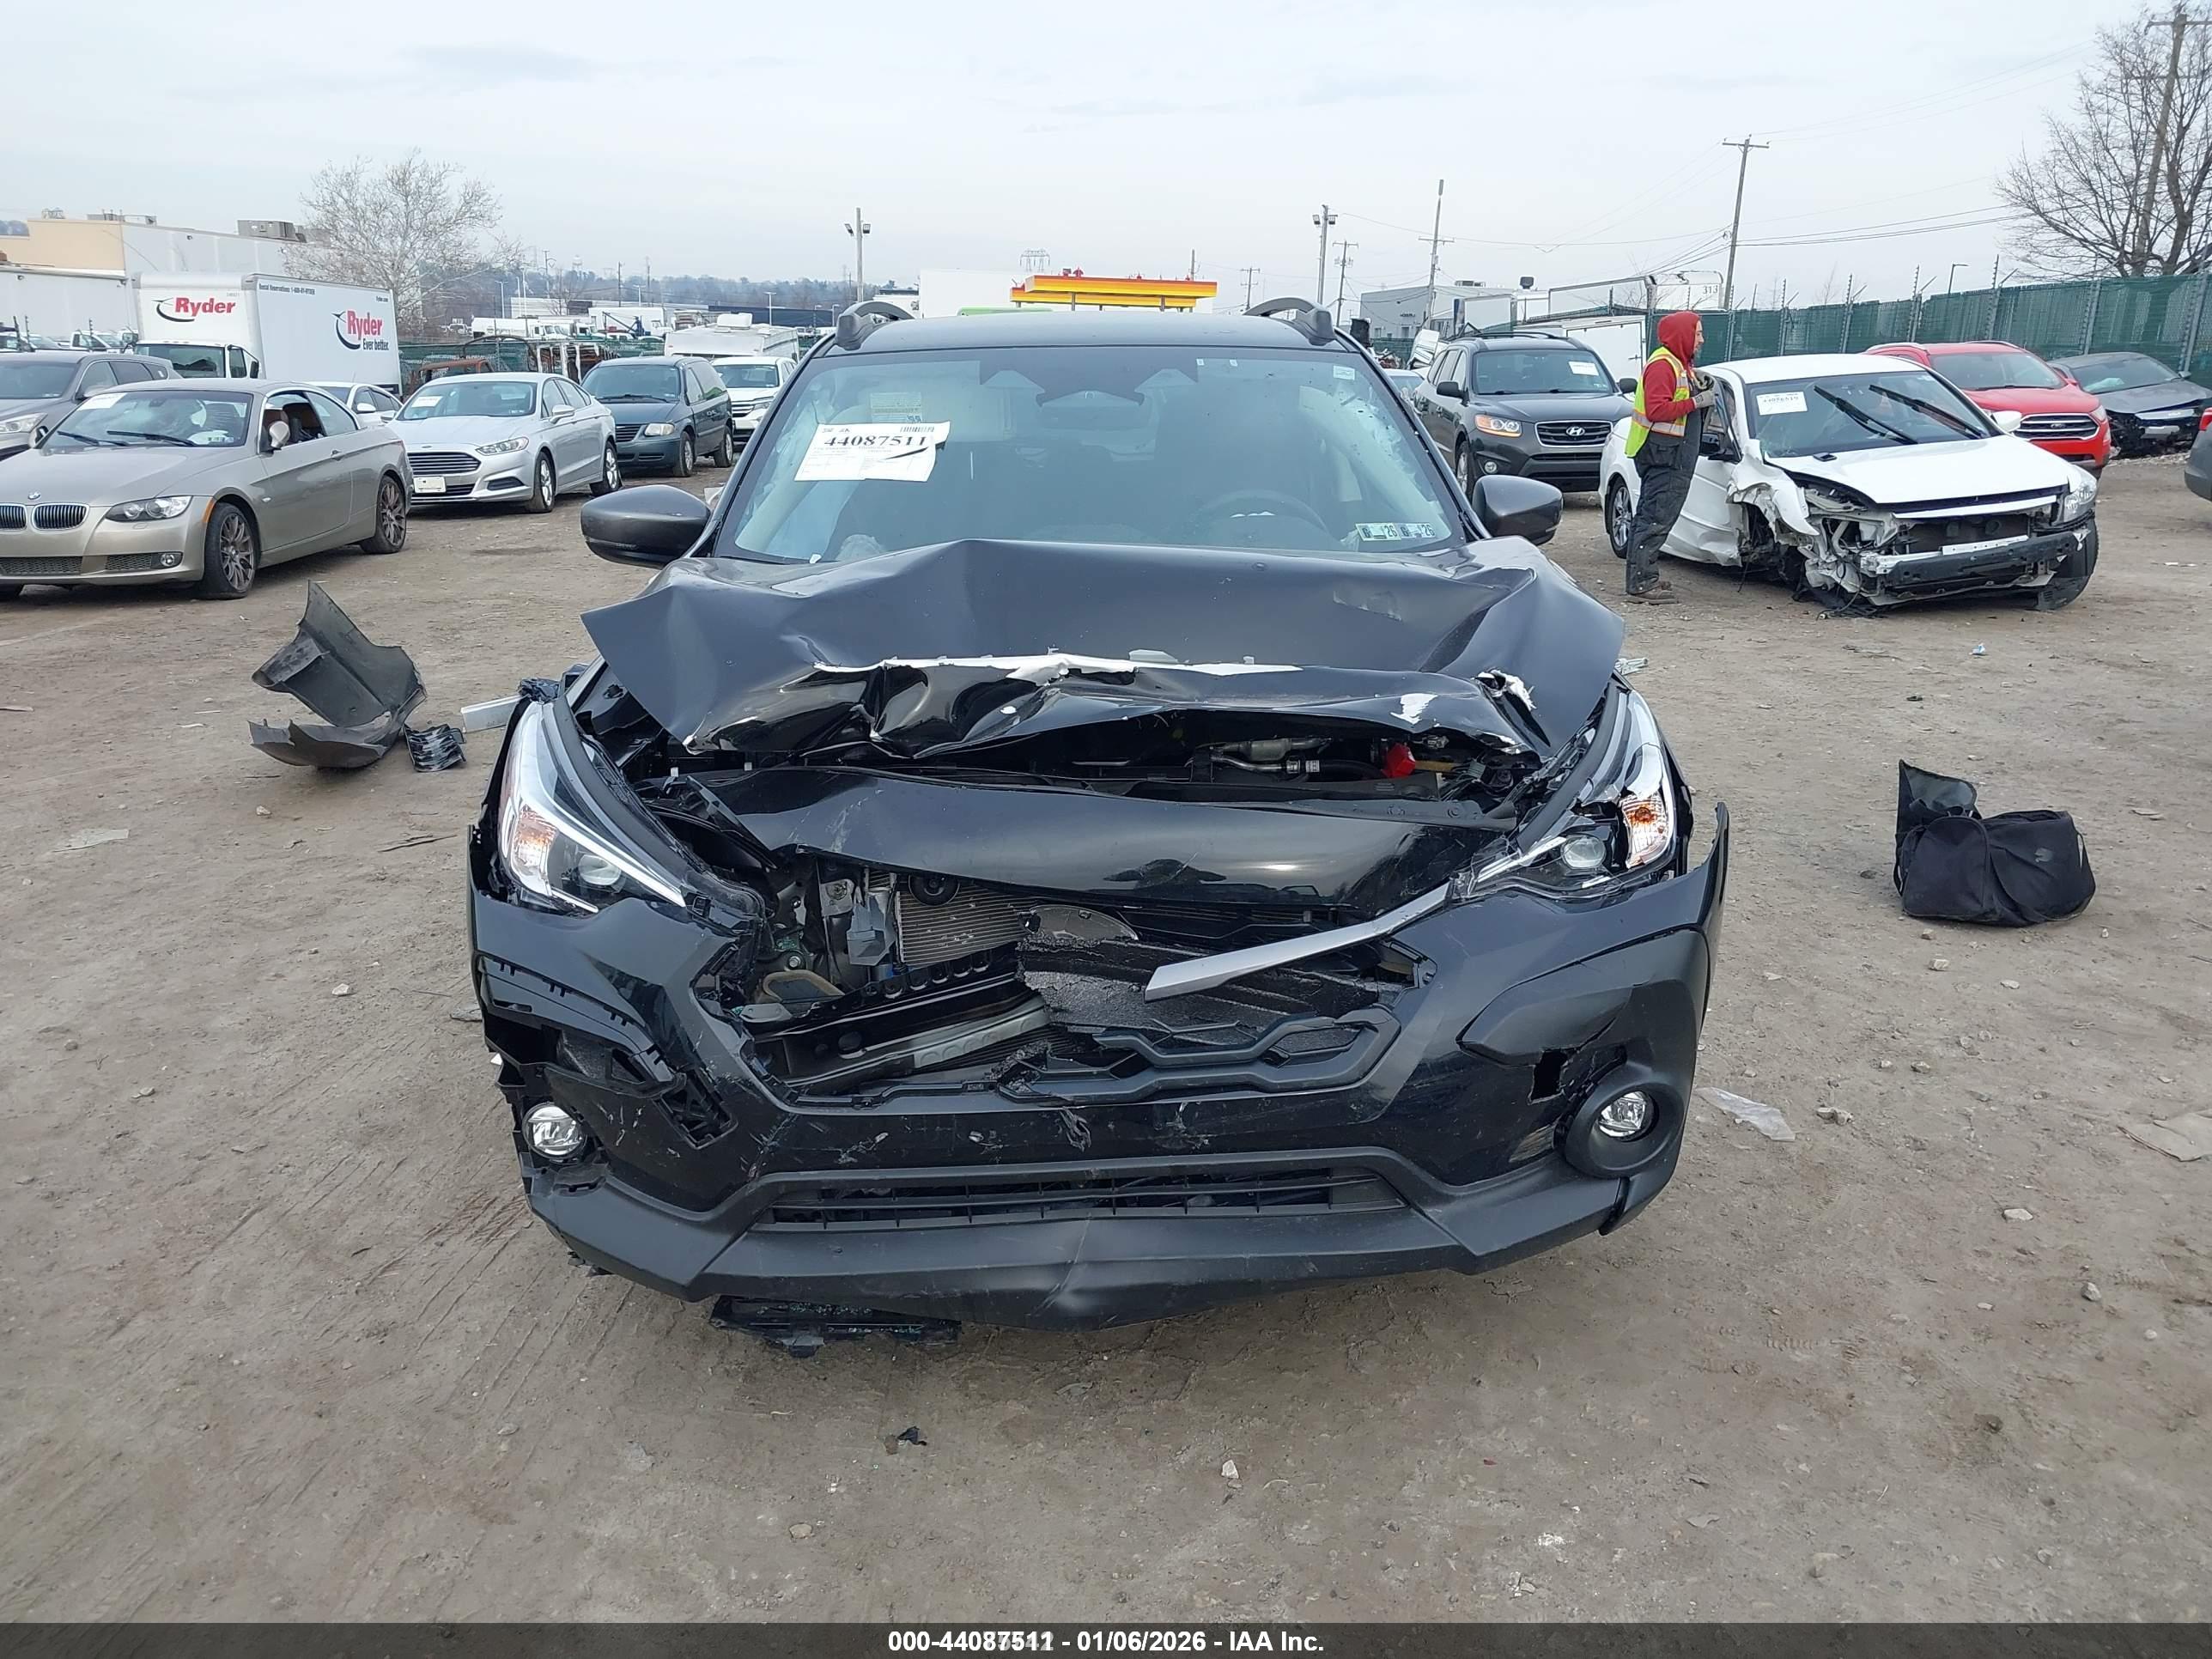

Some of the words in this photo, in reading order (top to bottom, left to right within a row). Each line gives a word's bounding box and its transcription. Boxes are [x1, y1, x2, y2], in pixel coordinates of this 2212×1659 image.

[175, 297, 236, 317] Ryder
[347, 310, 383, 341] Ryder
[362, 337, 374, 350] Ever
[824, 435, 927, 447] 44087511
